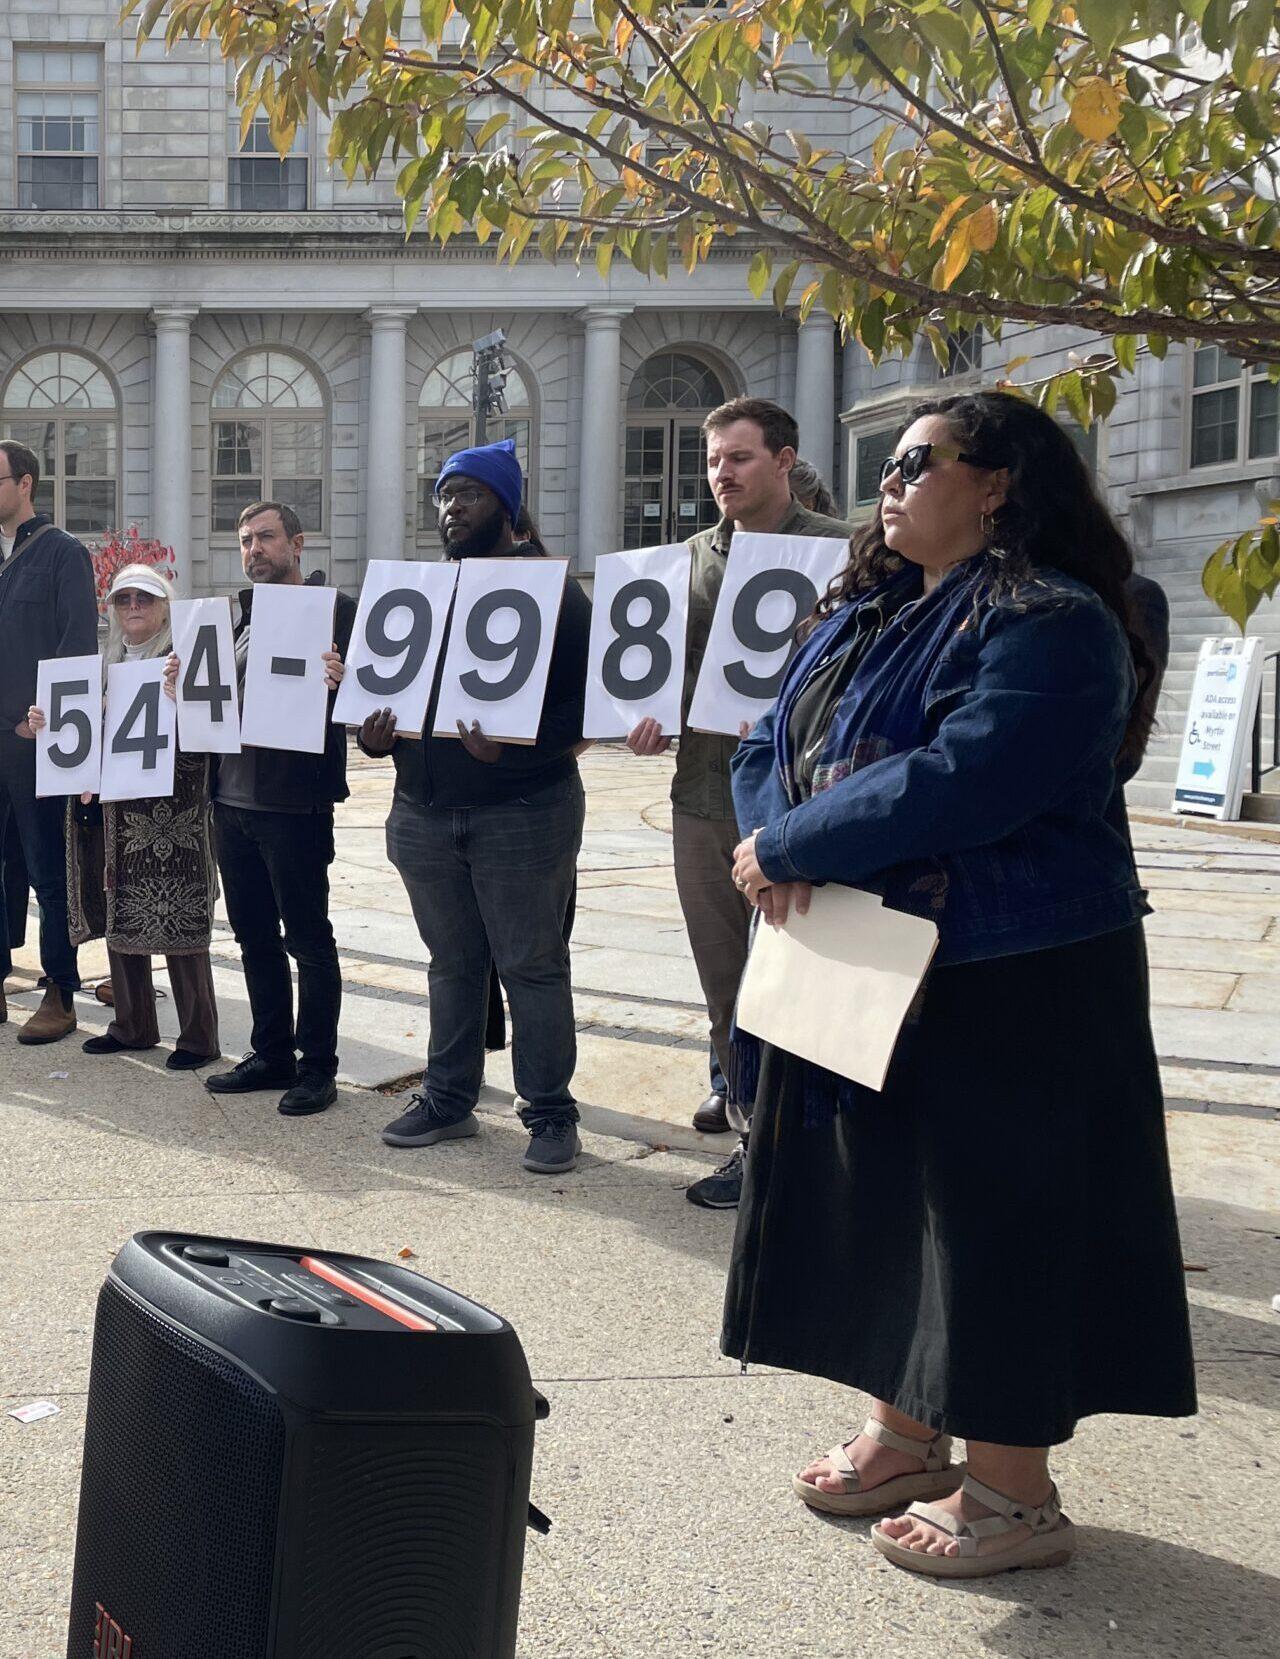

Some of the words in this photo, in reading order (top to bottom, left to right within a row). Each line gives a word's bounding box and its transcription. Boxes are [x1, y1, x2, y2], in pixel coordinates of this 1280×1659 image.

[47, 680, 92, 768] 5
[111, 682, 169, 770] 4
[182, 624, 232, 723] 4
[356, 588, 433, 696] 9
[459, 588, 542, 702] 9
[601, 578, 672, 701] 8
[723, 568, 818, 700] 9
[1205, 694, 1217, 703] ADA
[1218, 696, 1237, 704] access
[1200, 710, 1228, 720] available
[1205, 725, 1224, 737] Myrtle
[1201, 741, 1221, 751] Street
